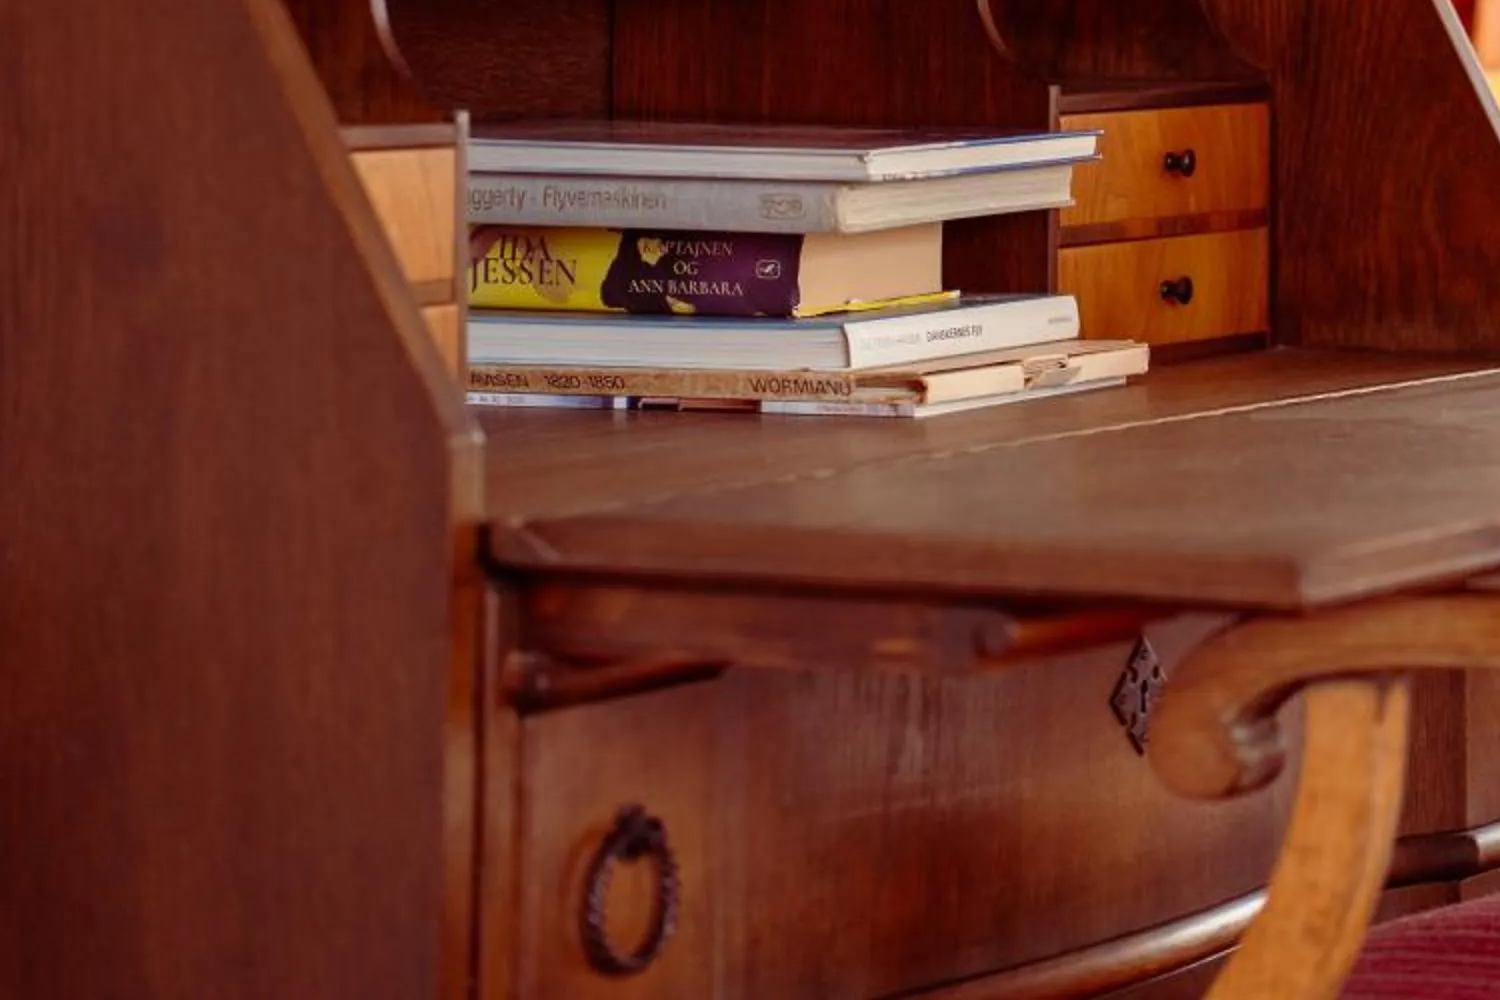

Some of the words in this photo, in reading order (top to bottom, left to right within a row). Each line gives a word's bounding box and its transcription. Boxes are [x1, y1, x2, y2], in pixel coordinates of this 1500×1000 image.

[468, 186, 527, 213] ggerty
[542, 184, 668, 212] Flyvemaskinen
[499, 234, 553, 260] IDA
[471, 256, 578, 293] JESSEN
[673, 260, 700, 276] OG
[628, 279, 664, 294] ANN
[667, 280, 744, 297] BARBARA
